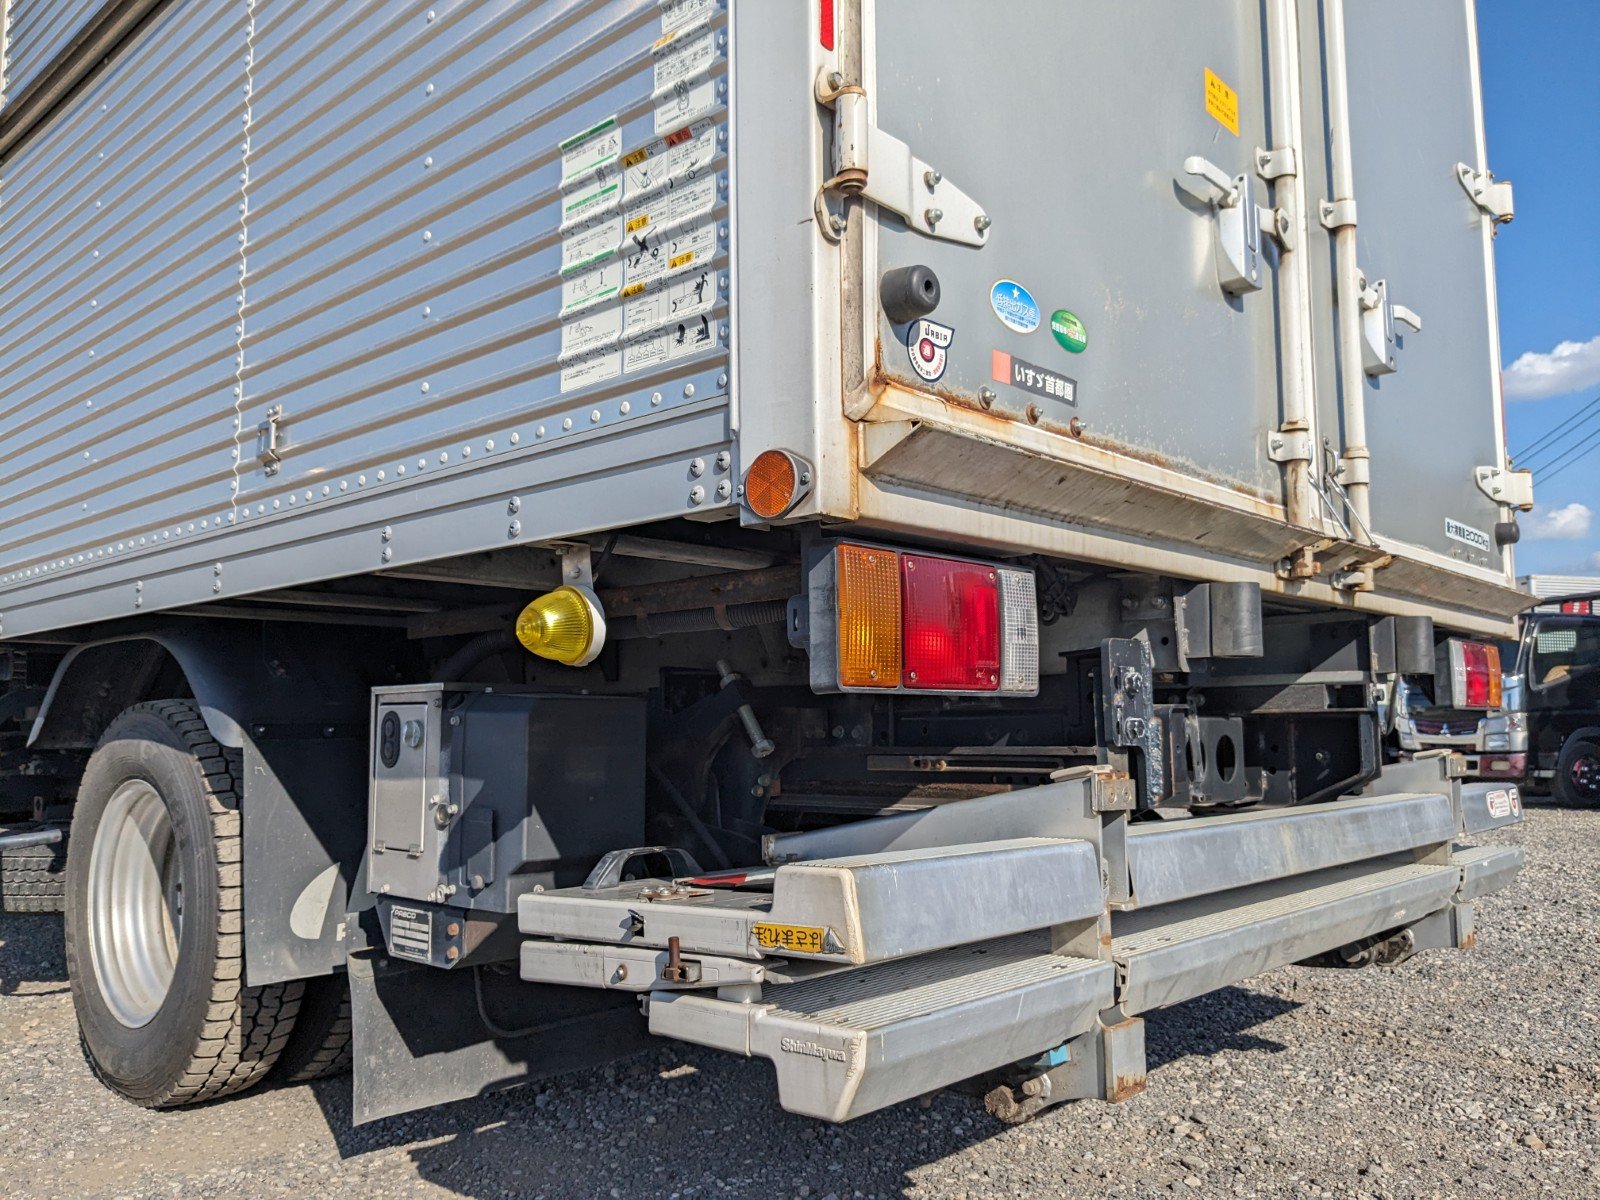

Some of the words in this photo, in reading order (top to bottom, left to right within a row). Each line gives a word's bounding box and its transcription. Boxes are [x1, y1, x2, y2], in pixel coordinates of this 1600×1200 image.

[924, 324, 948, 342] JABIA
[1014, 363, 1073, 402] いすゞ首都圏
[780, 1037, 846, 1062] ShinMaywa
